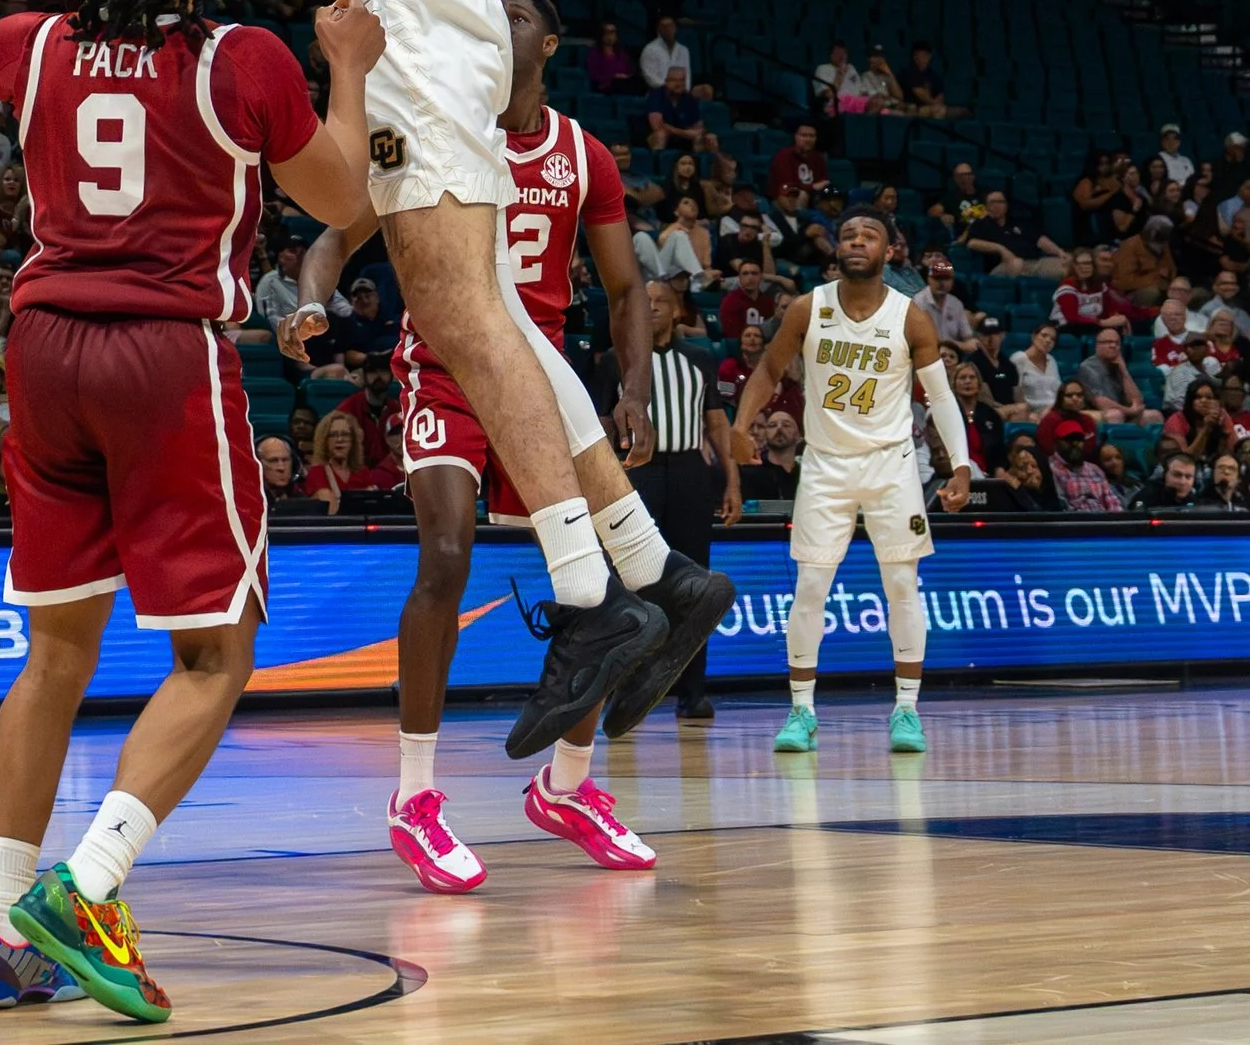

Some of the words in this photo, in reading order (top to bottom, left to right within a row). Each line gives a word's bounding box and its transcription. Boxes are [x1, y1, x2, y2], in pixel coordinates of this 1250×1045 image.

[73, 40, 159, 79] PACK
[76, 93, 147, 217] 9
[546, 155, 570, 180] SEC
[816, 338, 892, 373] BUFFS
[822, 373, 878, 415] 24
[411, 407, 447, 450] OU
[1014, 574, 1055, 628] is
[1065, 586, 1139, 627] our
[1149, 572, 1250, 625] MVP
